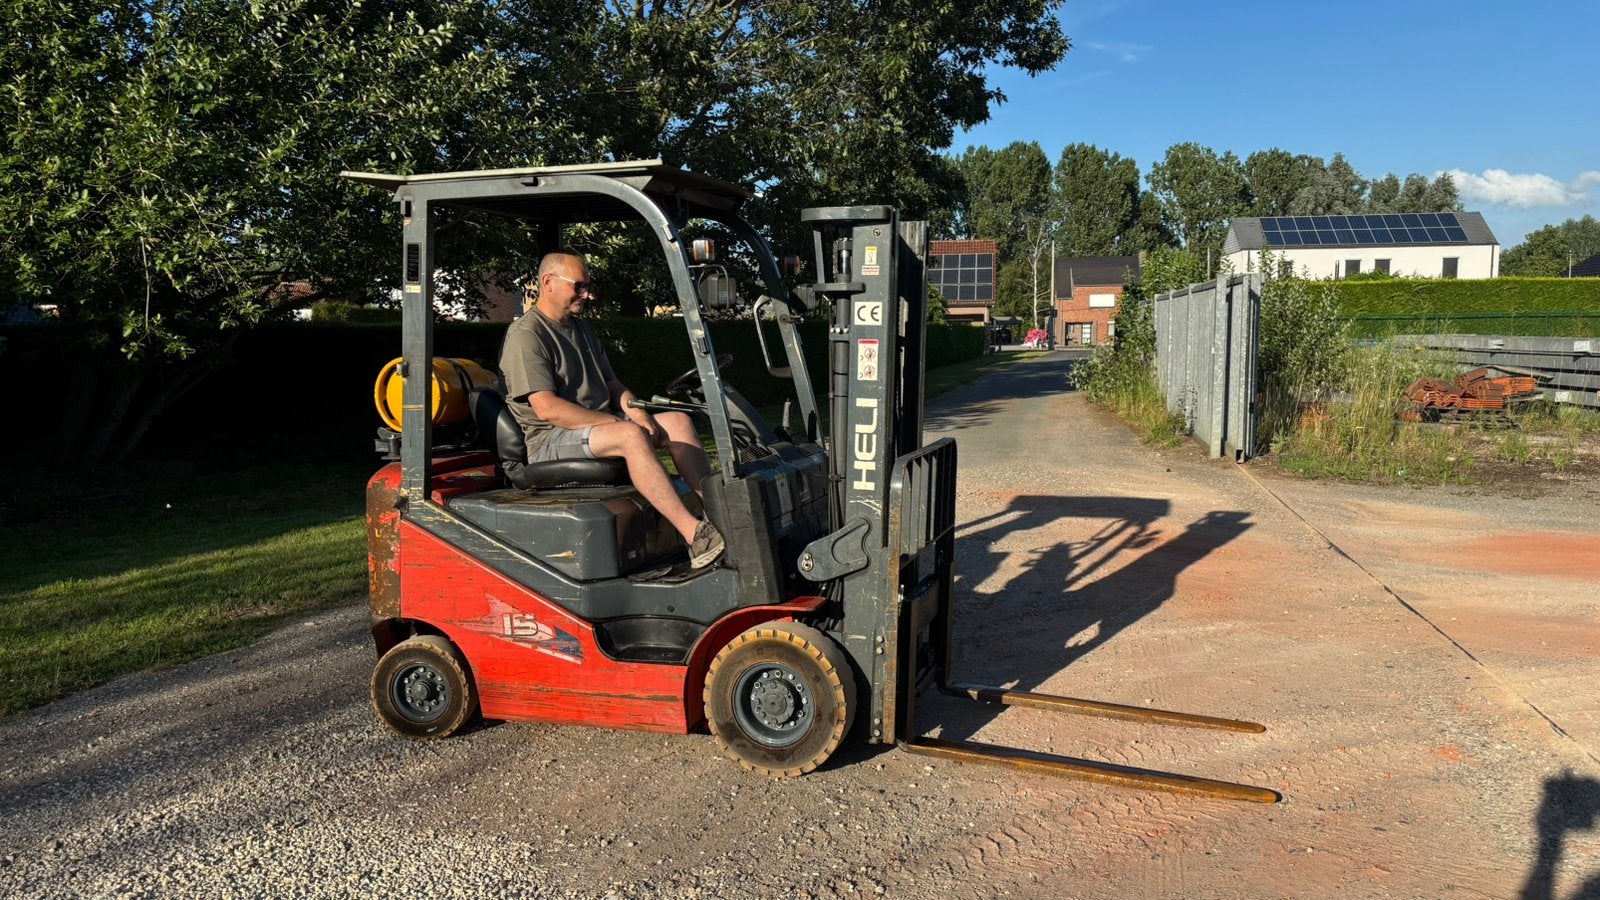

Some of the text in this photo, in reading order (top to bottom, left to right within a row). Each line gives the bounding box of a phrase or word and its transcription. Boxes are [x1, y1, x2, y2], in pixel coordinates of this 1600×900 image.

[857, 305, 880, 322] CE
[853, 397, 878, 491] HELI
[503, 612, 539, 638] 15
